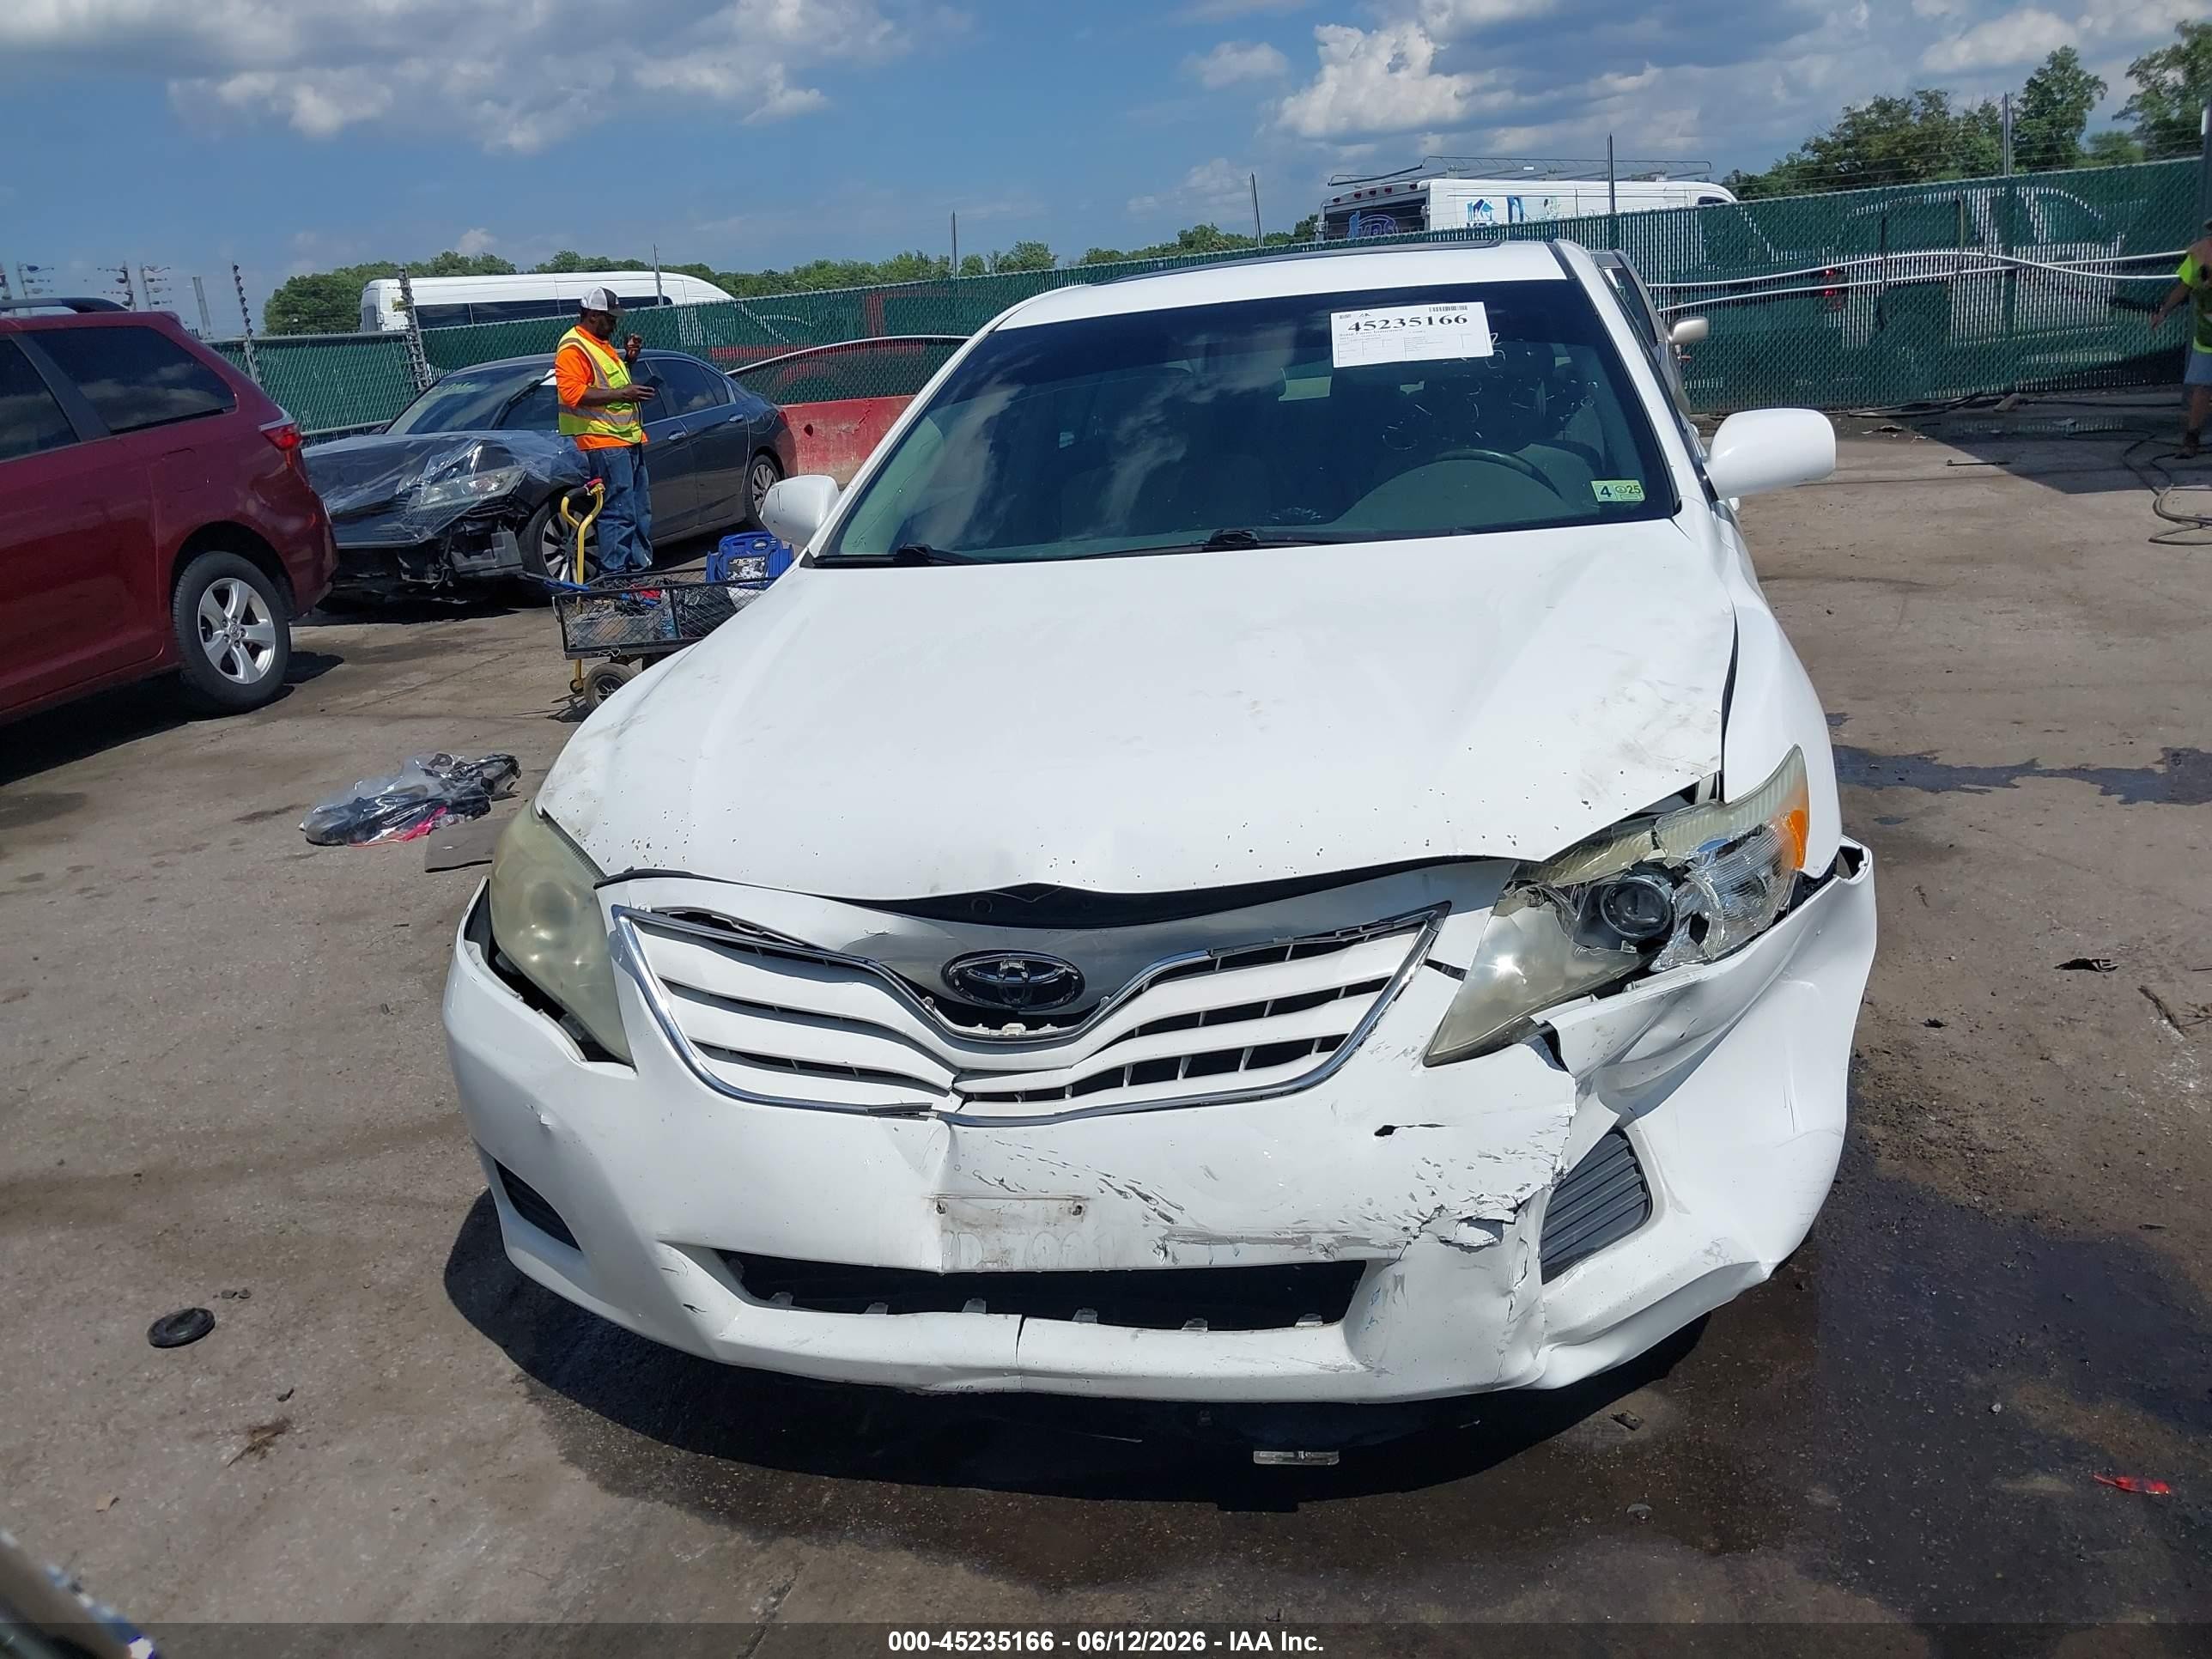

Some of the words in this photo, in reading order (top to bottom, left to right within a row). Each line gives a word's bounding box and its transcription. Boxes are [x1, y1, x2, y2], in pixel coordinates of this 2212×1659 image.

[1348, 314, 1468, 332] 45235166
[1600, 485, 1613, 498] 4
[1626, 484, 1641, 495] 25
